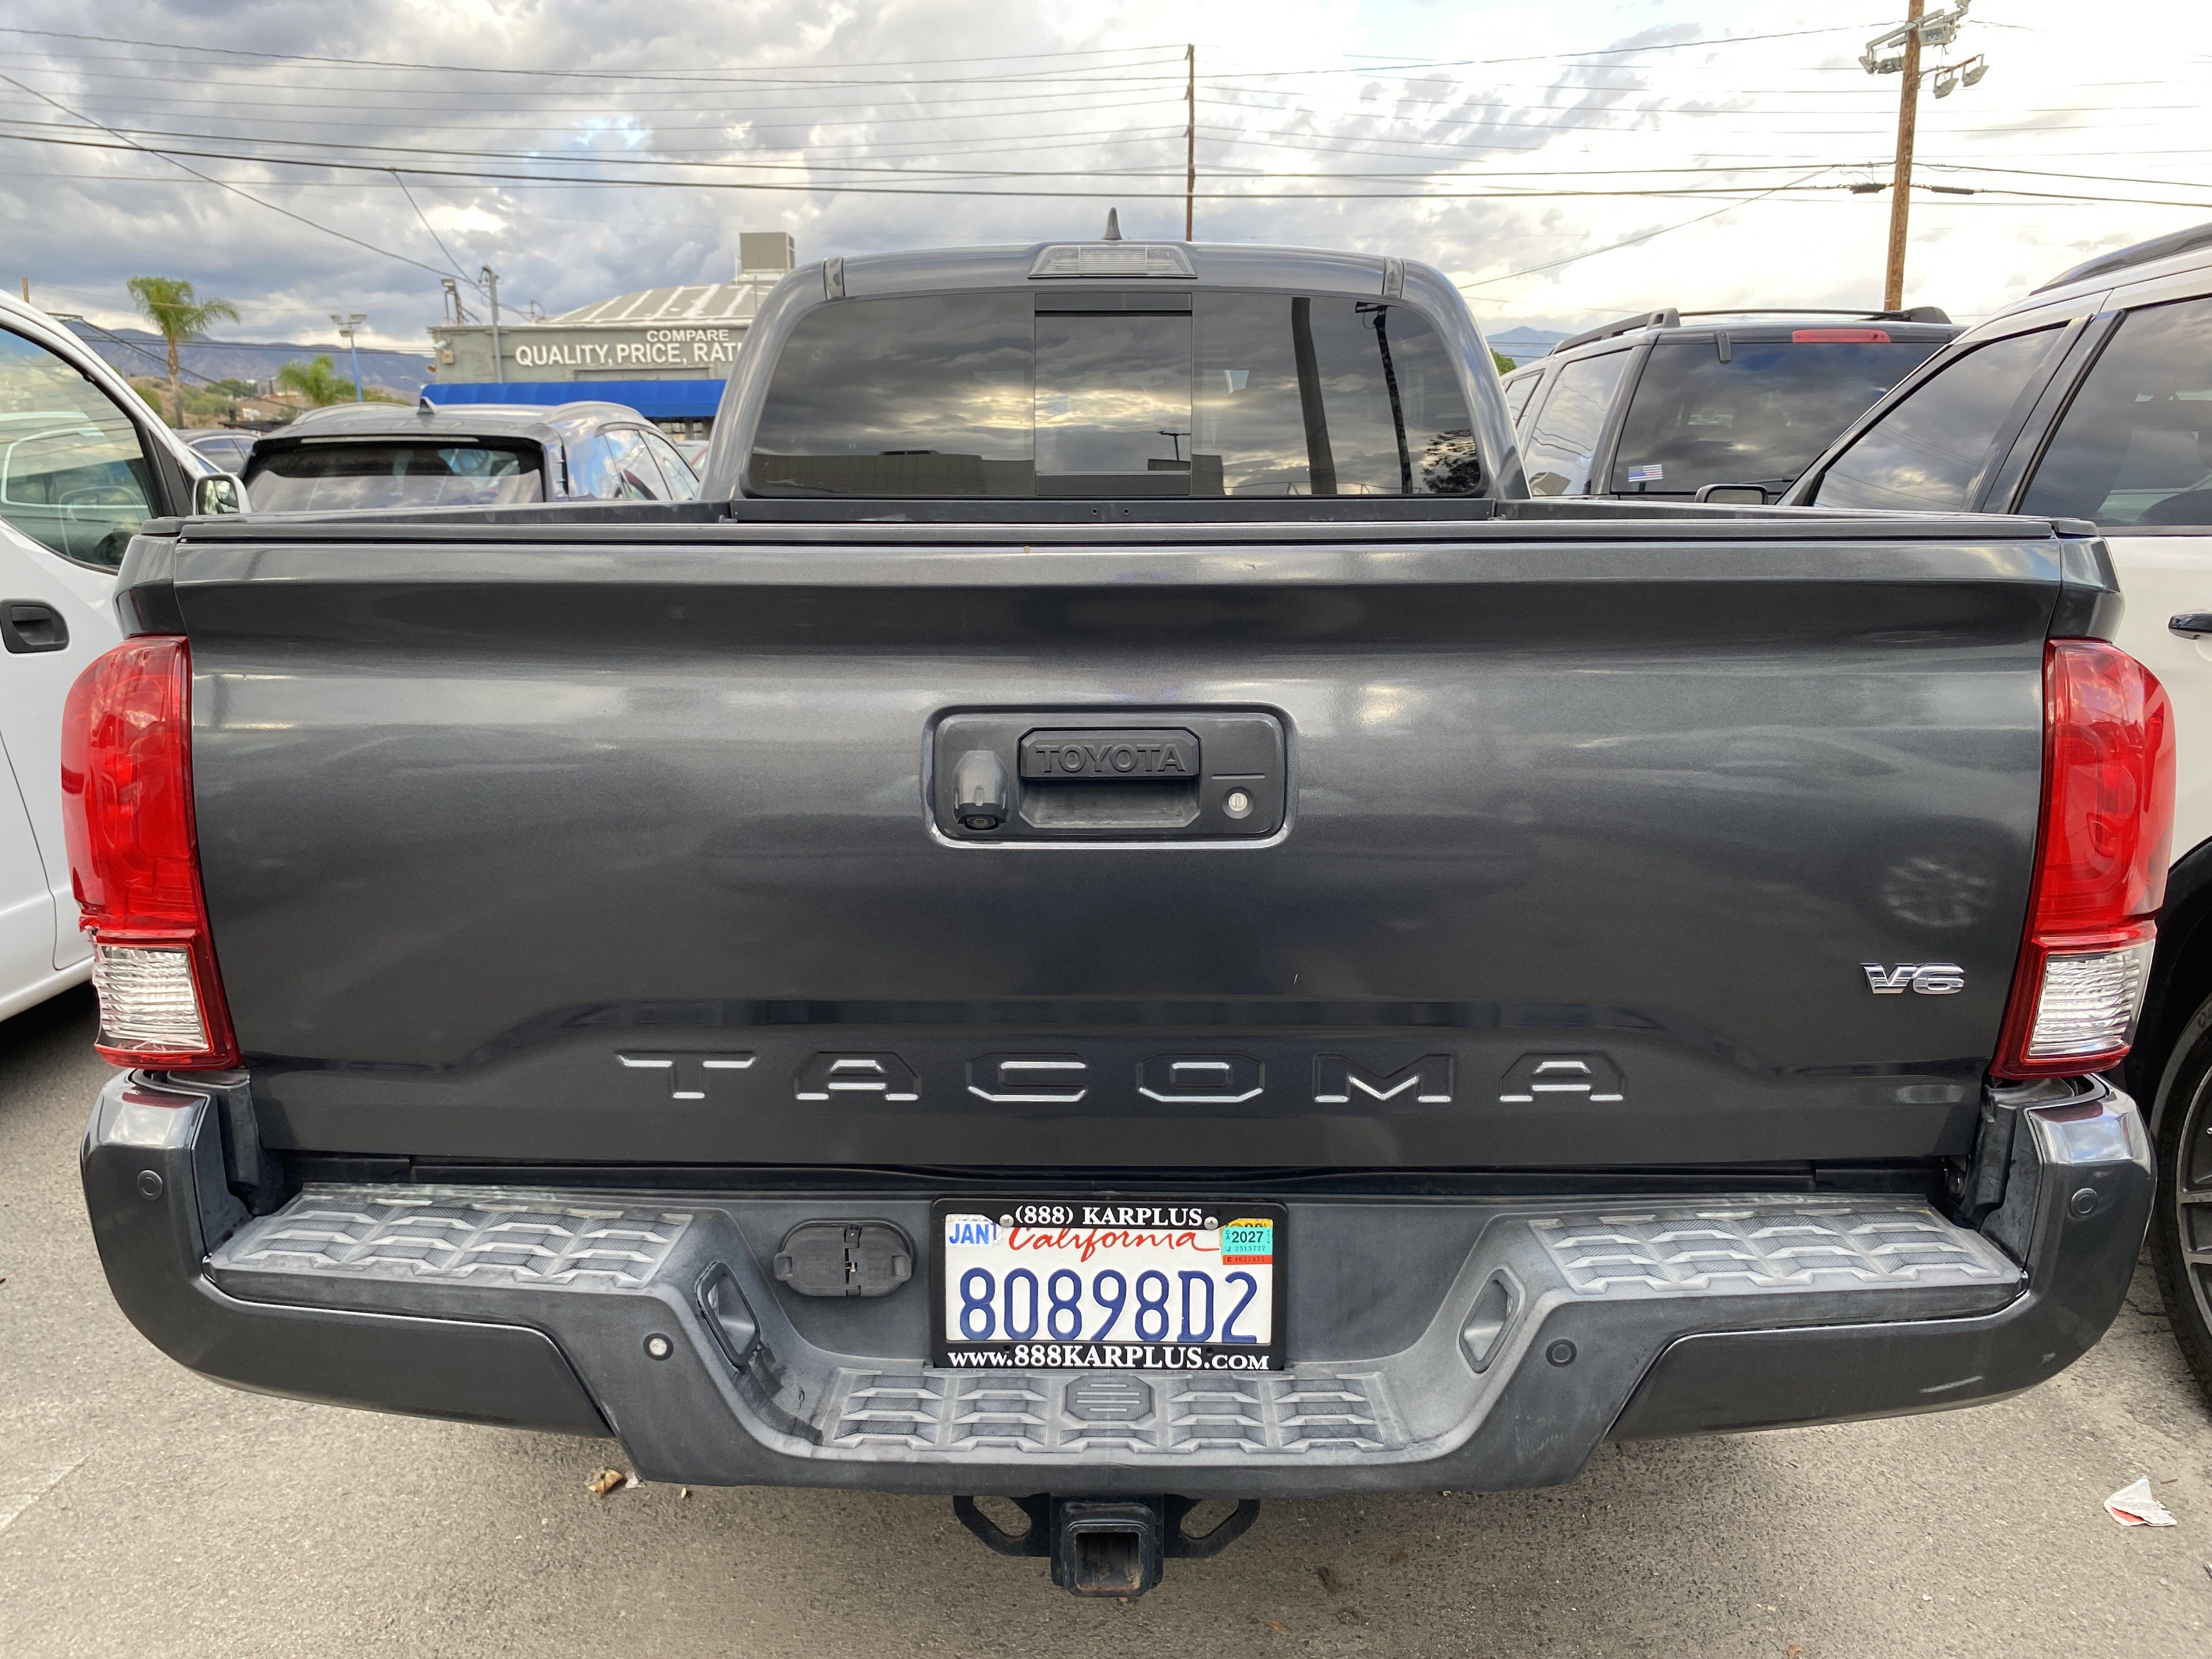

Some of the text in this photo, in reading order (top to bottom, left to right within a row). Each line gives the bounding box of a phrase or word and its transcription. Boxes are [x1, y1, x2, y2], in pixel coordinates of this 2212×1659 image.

[646, 330, 730, 342] COMPARE
[515, 344, 613, 366] QUALITY,
[617, 342, 687, 366] PRICE,
[1036, 744, 1186, 773] TOYOTA
[1860, 962, 1965, 995] V6
[613, 1050, 1627, 1104] TACOMA
[1015, 1205, 1203, 1226] (888) KARPLUS
[949, 1224, 989, 1244] JAN
[1009, 1227, 1220, 1262] California
[1232, 1231, 1263, 1243] 2027
[960, 1267, 1257, 1342] 80898D2
